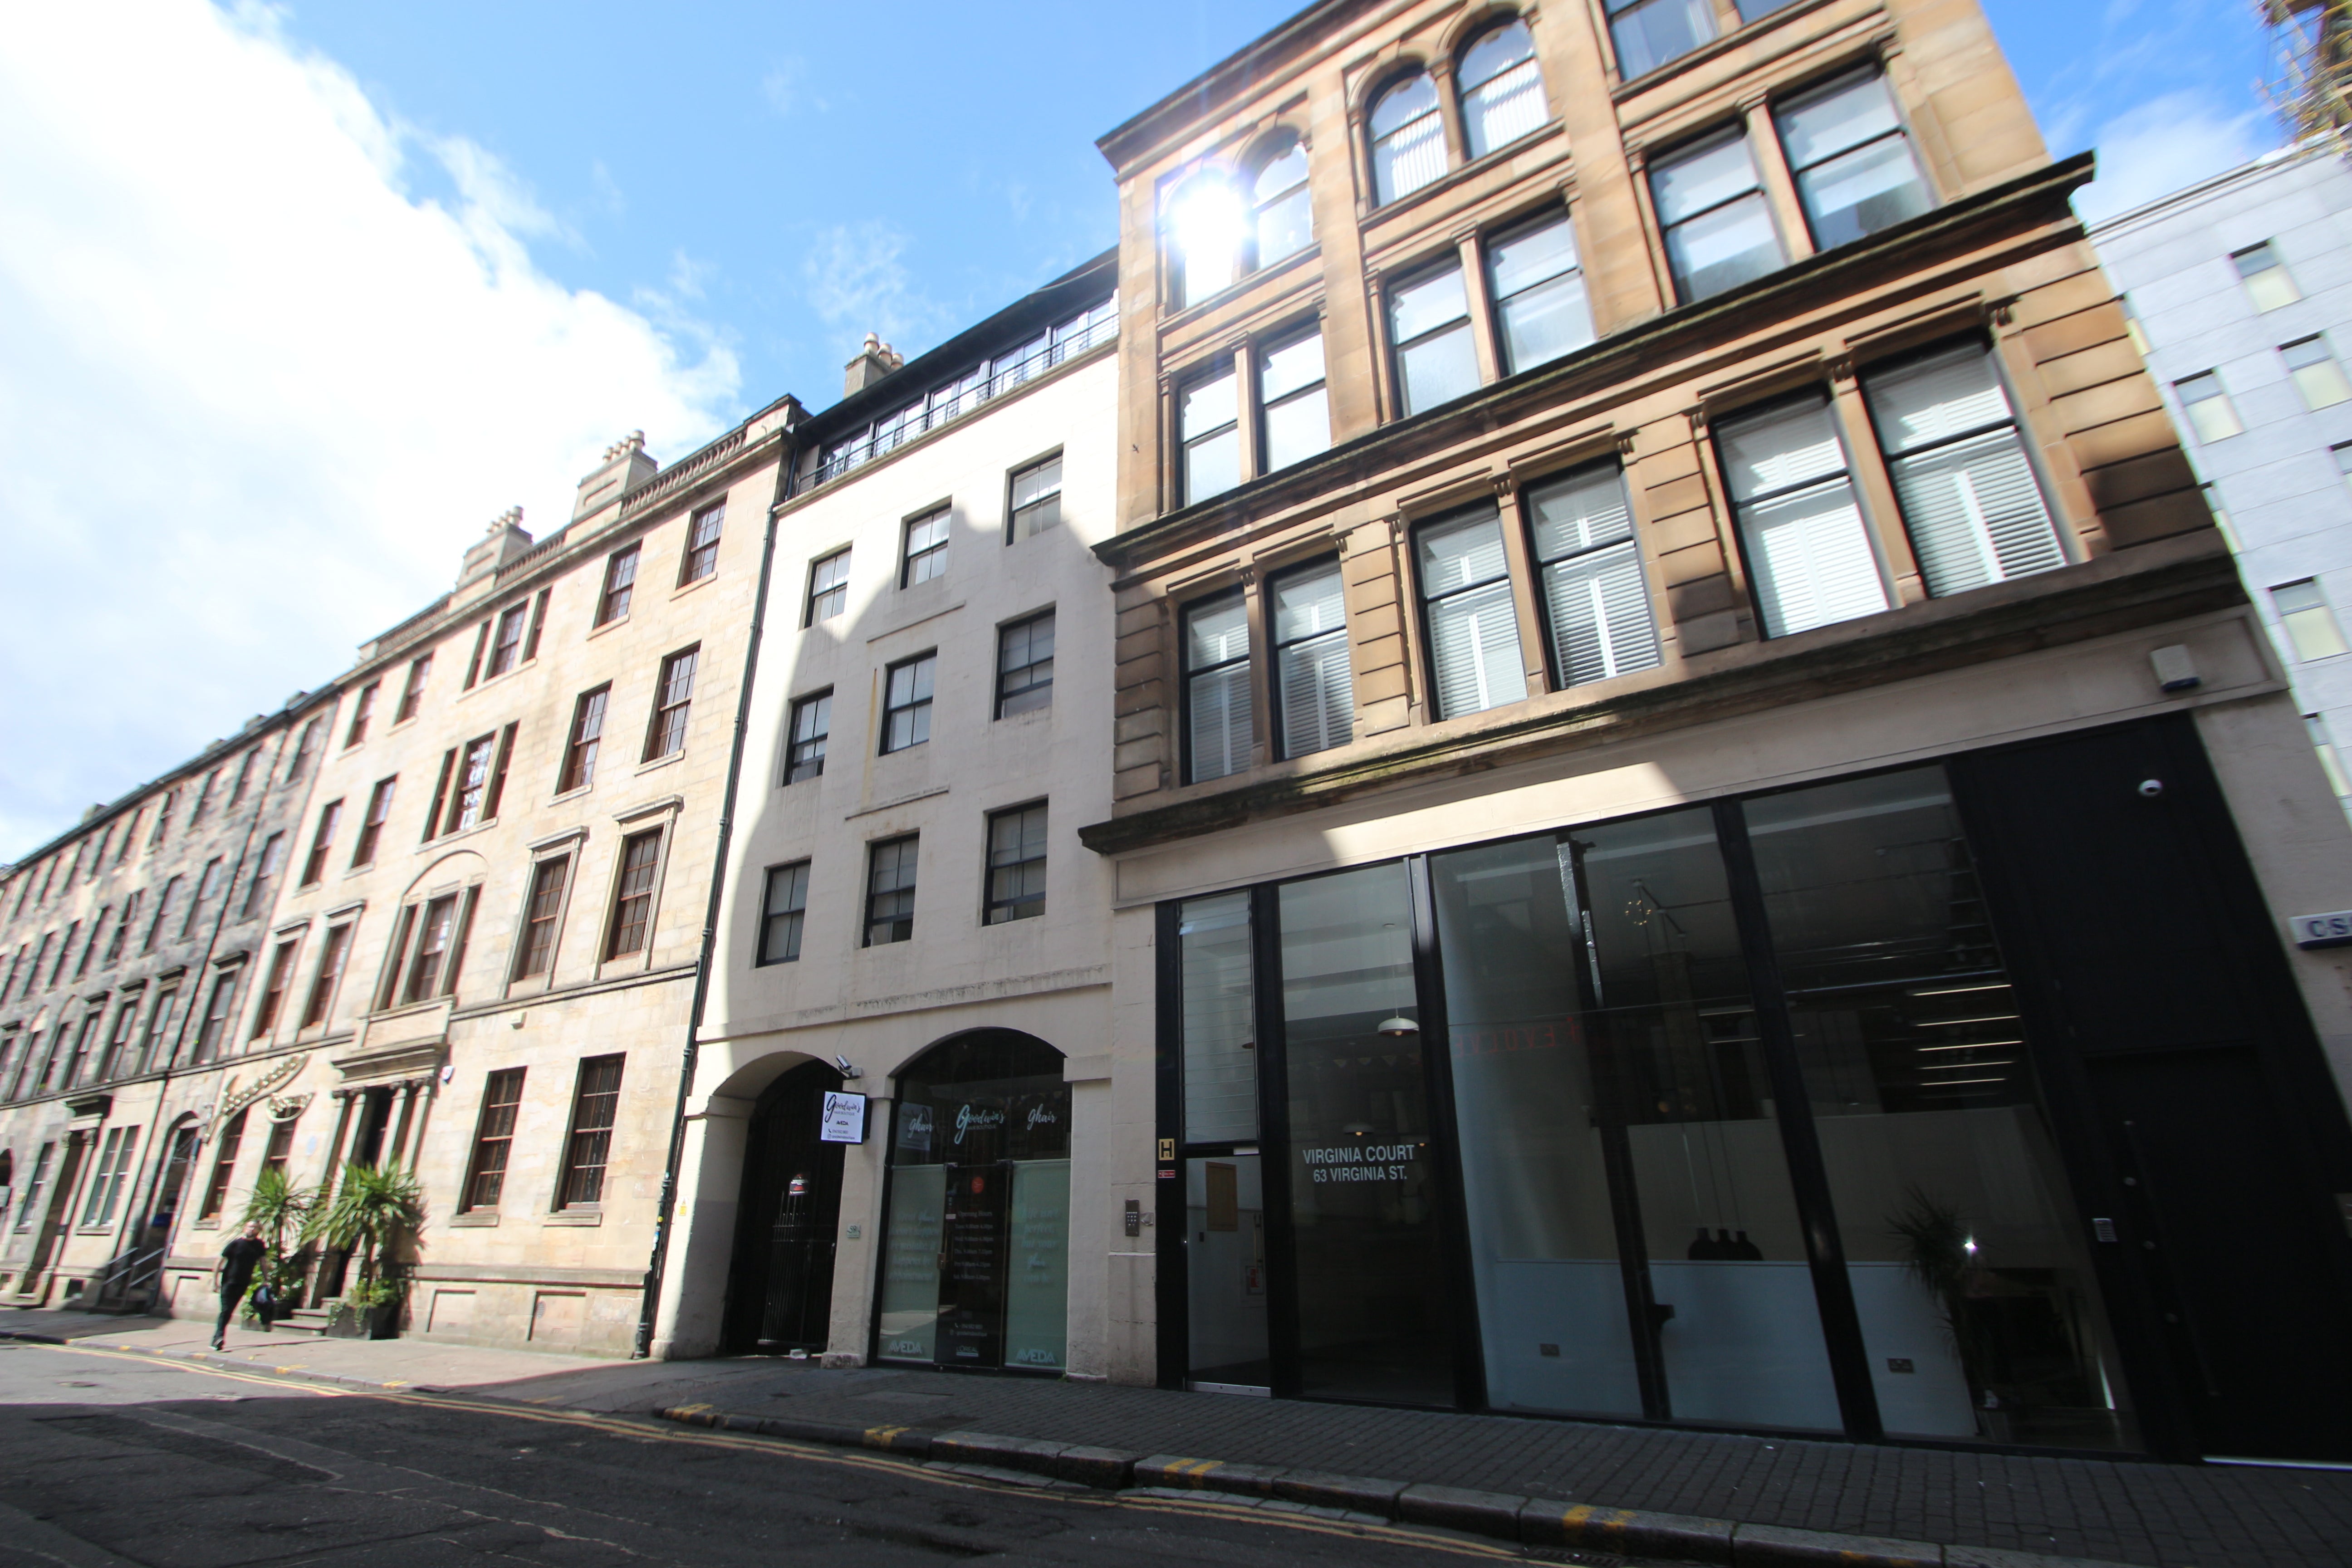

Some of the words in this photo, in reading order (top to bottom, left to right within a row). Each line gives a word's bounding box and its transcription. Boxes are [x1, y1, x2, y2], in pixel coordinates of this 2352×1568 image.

[1161, 1141, 1172, 1157] H
[1303, 1147, 1363, 1164] VIRGINIA
[1365, 1144, 1415, 1162] COURT
[1313, 1168, 1327, 1183] 63
[1329, 1166, 1386, 1182] VIRGINIA
[1388, 1165, 1407, 1181] ST.
[888, 1339, 922, 1354] AVEDA
[1016, 1348, 1055, 1364] AVEDA
